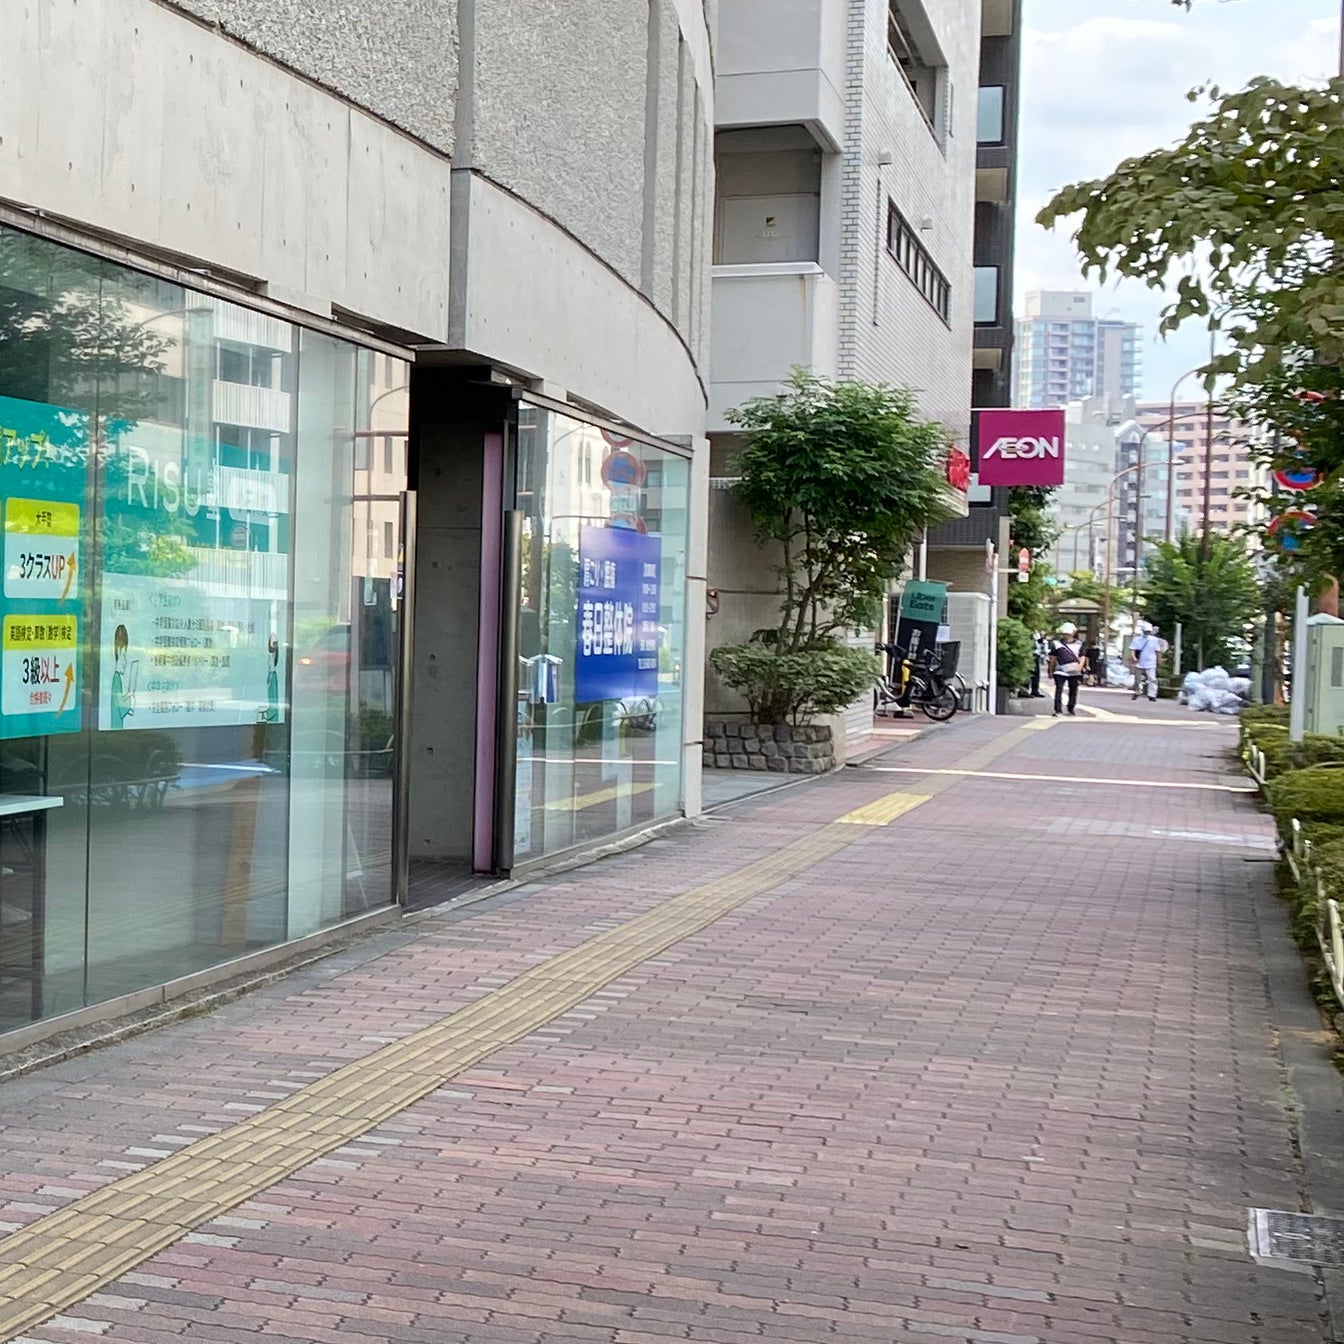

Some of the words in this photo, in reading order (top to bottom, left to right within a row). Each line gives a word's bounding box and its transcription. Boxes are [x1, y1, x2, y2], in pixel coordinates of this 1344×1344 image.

[19, 552, 65, 580] 3クラスUP
[22, 655, 60, 685] 3級以上
